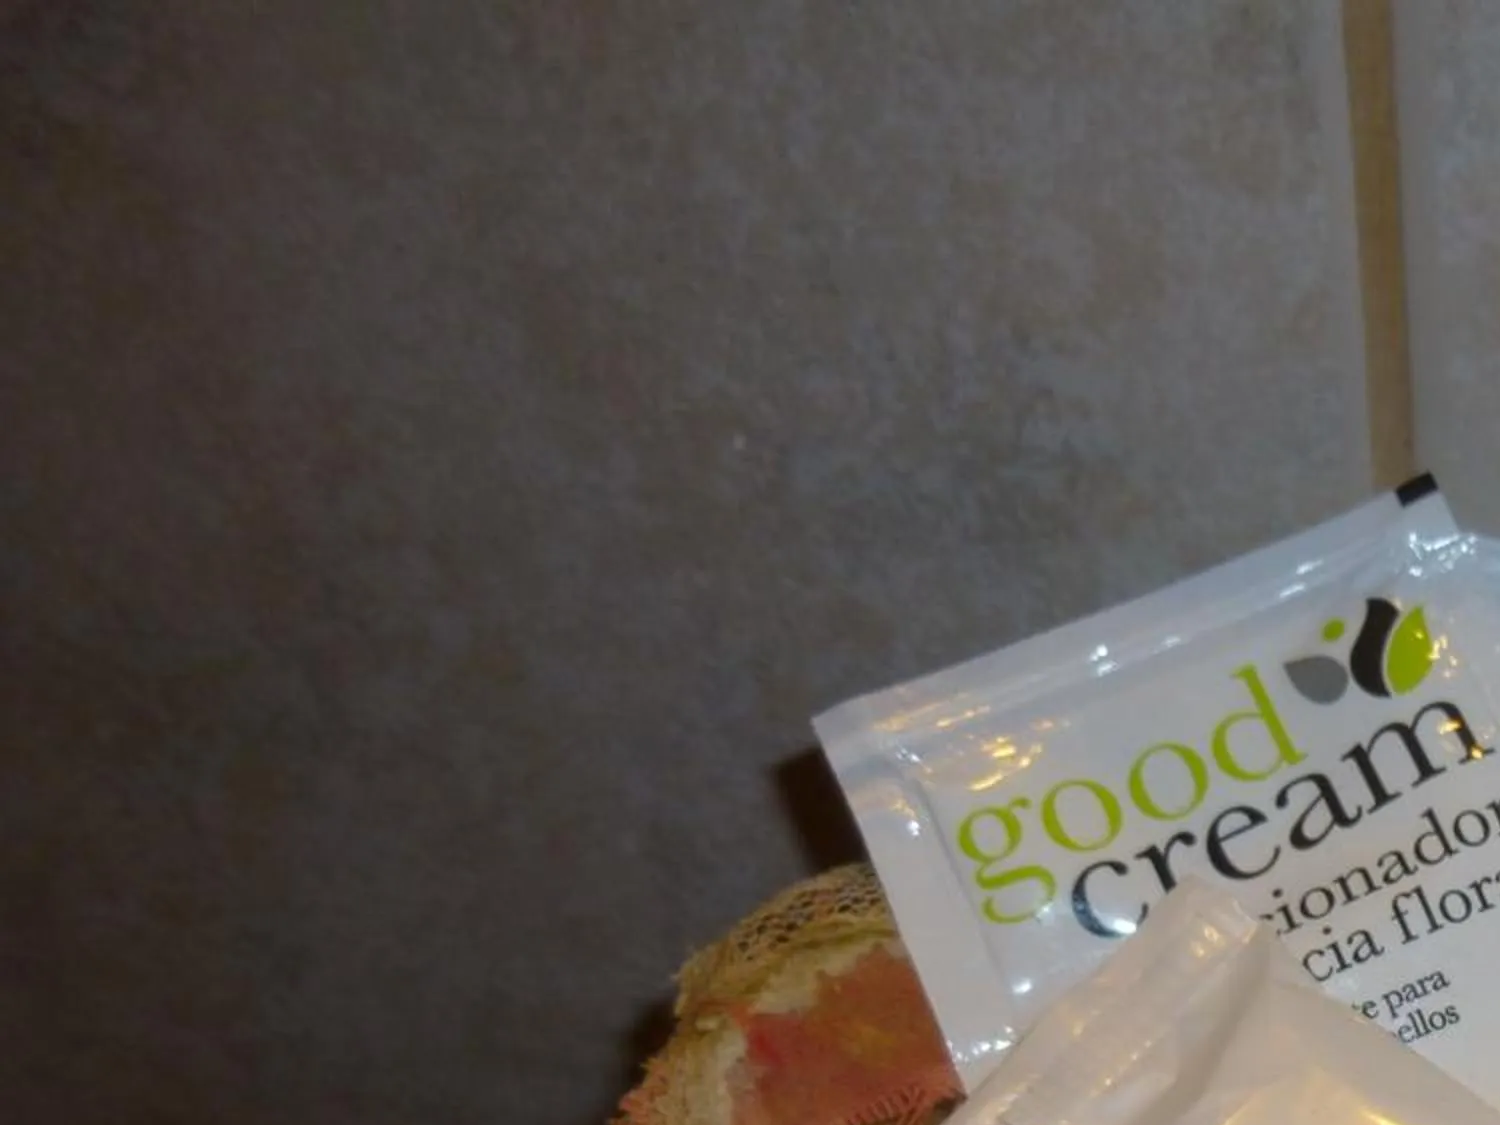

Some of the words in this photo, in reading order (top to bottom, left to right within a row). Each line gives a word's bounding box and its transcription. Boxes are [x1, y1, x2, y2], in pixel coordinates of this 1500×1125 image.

[957, 664, 1308, 925] good
[1071, 701, 1495, 940] cream
[1383, 969, 1451, 1019] para
